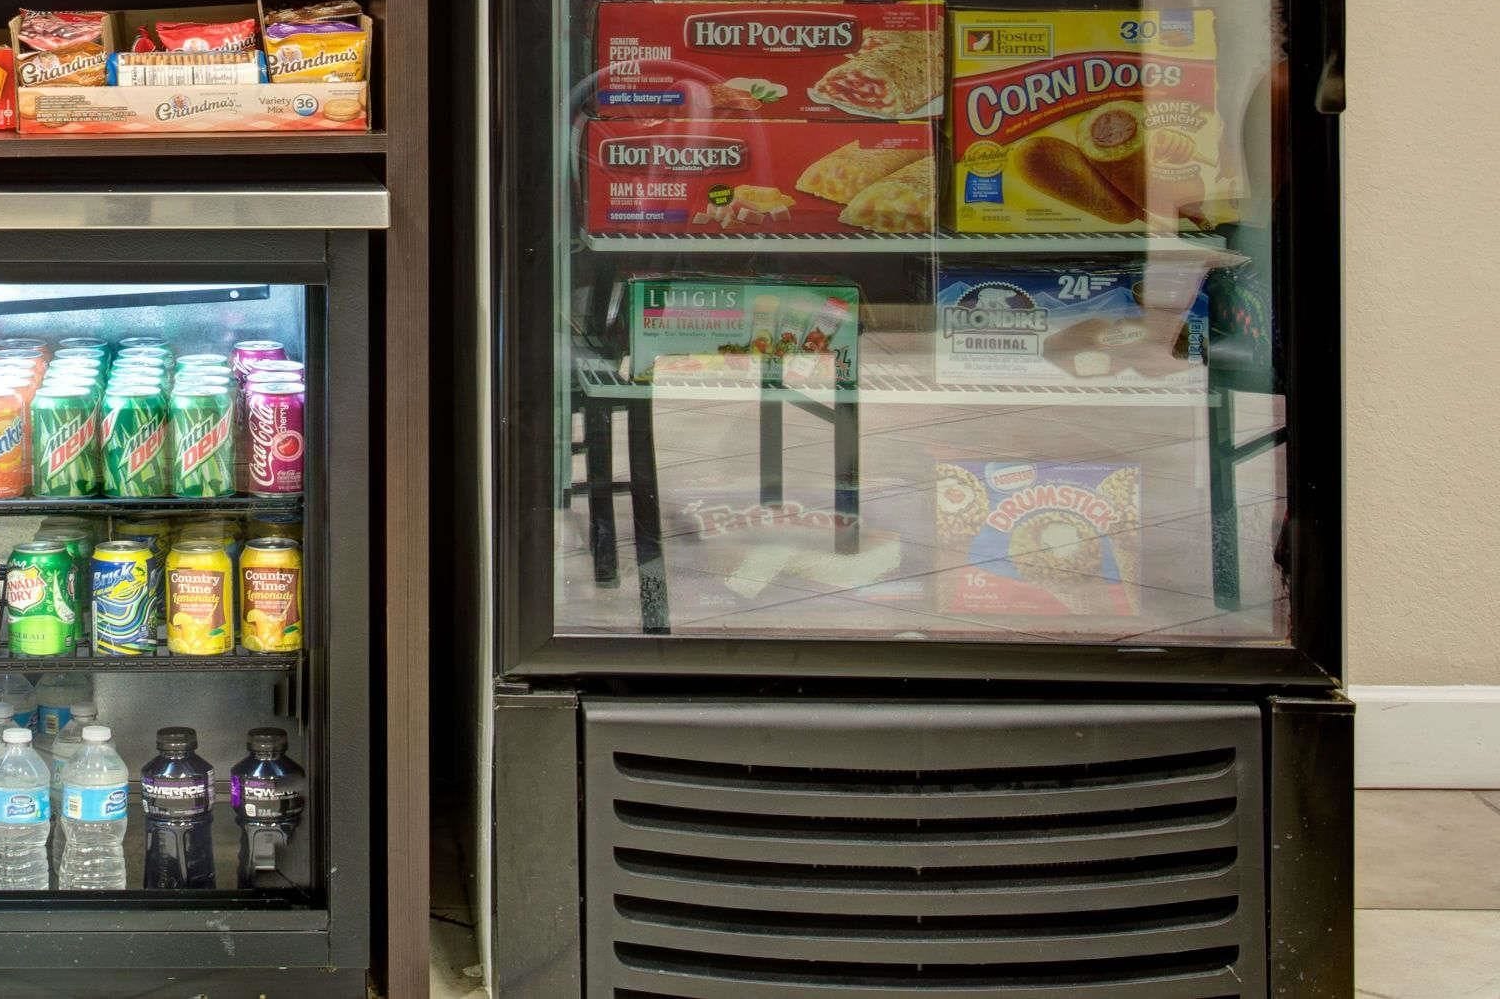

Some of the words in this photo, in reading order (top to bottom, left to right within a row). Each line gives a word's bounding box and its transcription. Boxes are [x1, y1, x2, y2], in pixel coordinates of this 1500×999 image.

[696, 22, 743, 45] HOT
[747, 21, 853, 48] POCKETS
[996, 29, 1045, 44] Foster
[1120, 20, 1157, 40] 30
[610, 46, 671, 60] PEPPERONI
[996, 43, 1045, 54] Farms
[610, 61, 640, 75] PIZZA
[258, 96, 292, 106] Variety
[297, 98, 314, 109] 36
[610, 93, 632, 104] garlic
[633, 93, 661, 104] buttery
[967, 64, 1077, 137] CORN
[1083, 58, 1182, 93] DOGS
[155, 96, 236, 121] Grandma's
[268, 106, 284, 114] Mix
[1147, 102, 1200, 116] HONEY
[1144, 113, 1205, 127] CRUNCHY
[609, 144, 650, 166] HOT
[653, 144, 741, 168] POCKETS
[610, 183, 633, 197] HAM
[637, 183, 645, 197] &
[647, 182, 687, 197] CHEESE
[646, 211, 664, 220] crust
[1058, 276, 1092, 300] 24
[650, 289, 737, 308] LUIGI'S
[643, 317, 673, 330] REAL
[676, 317, 721, 330] ITALIAN
[726, 317, 744, 330] ICE
[945, 308, 1047, 331] KLONDIKE
[965, 336, 1028, 350] ORIGINAL
[279, 404, 288, 434] cherry
[987, 484, 1120, 533] DRUMSTICK
[171, 572, 220, 586] Country
[245, 570, 295, 584] Country
[178, 583, 212, 594] Time
[252, 581, 286, 591] Time
[8, 590, 32, 602] DRY
[172, 593, 221, 604] lemonade
[246, 591, 294, 602] lemonade
